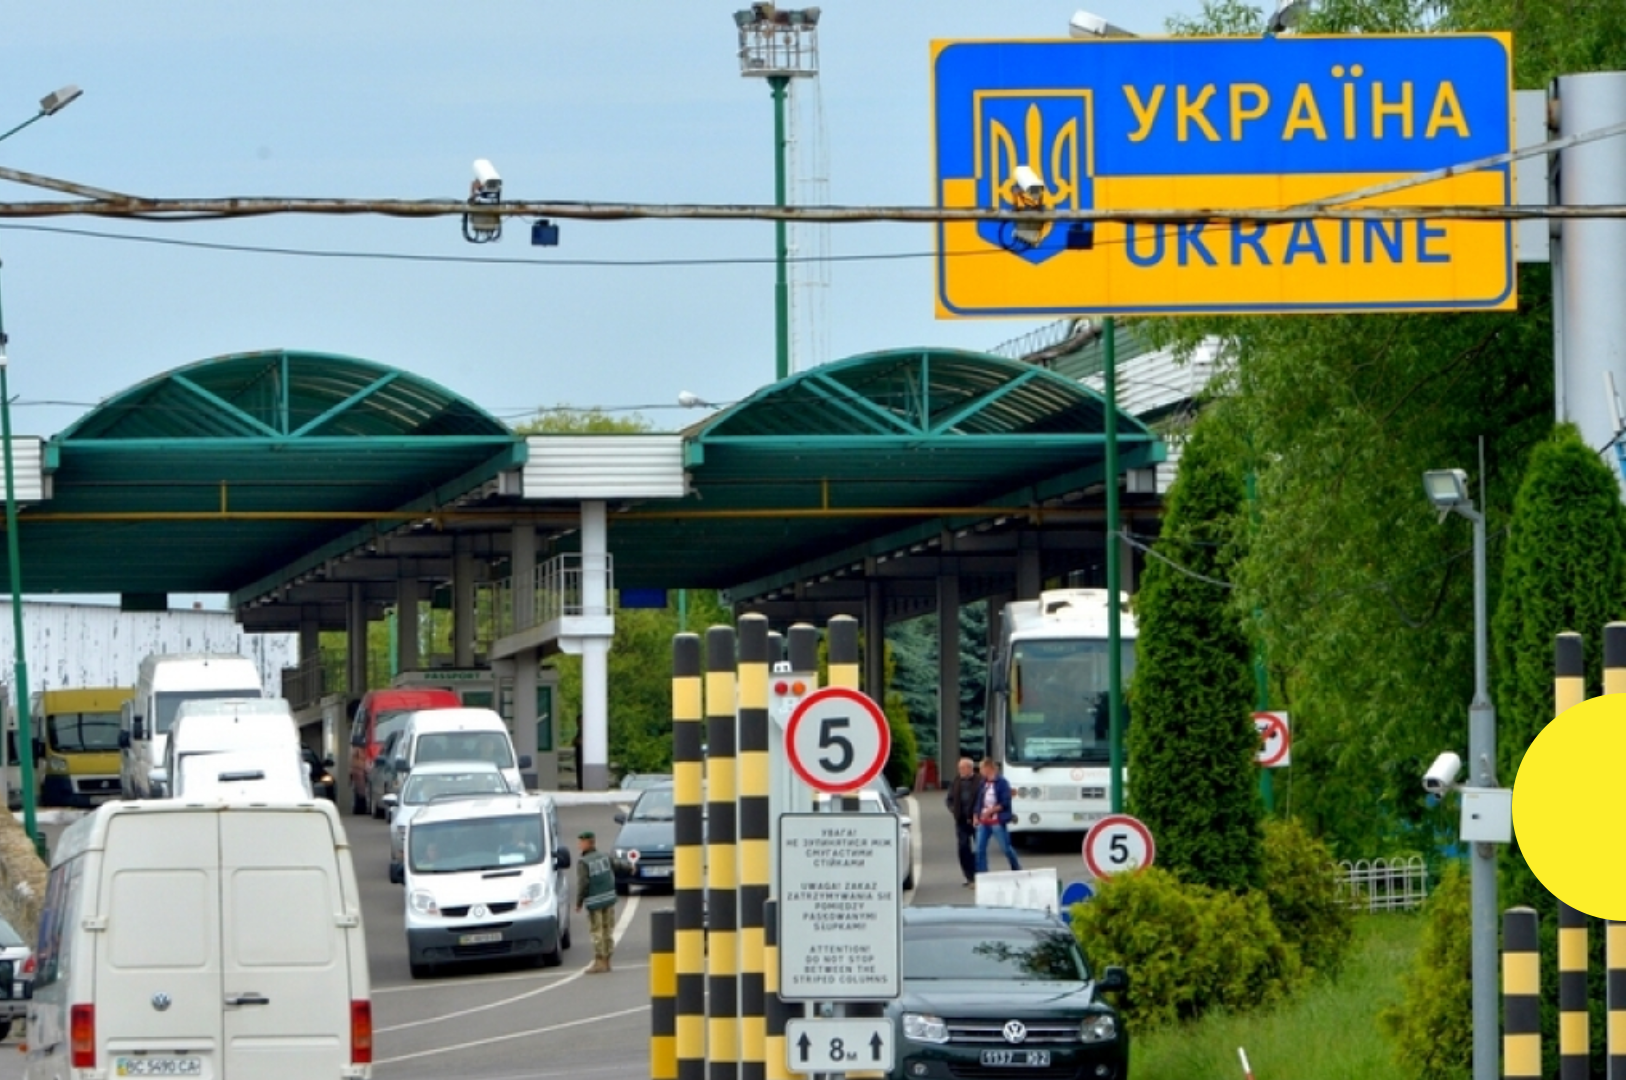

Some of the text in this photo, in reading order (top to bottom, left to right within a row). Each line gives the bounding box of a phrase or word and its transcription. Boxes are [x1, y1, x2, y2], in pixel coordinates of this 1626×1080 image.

[1123, 64, 1472, 143] УКРАЇНА
[1124, 219, 1452, 267] UKRAINE
[424, 671, 480, 679] PASSPORT
[818, 717, 854, 773] 5
[1109, 834, 1129, 865] 5
[845, 882, 877, 891] ZAKAZ
[787, 891, 873, 901] ZATRZYMYWANIA
[805, 955, 874, 964] DO NOT STOP
[804, 965, 876, 974] BETWEEN THE
[793, 975, 888, 984] STRIPED COLUMNS
